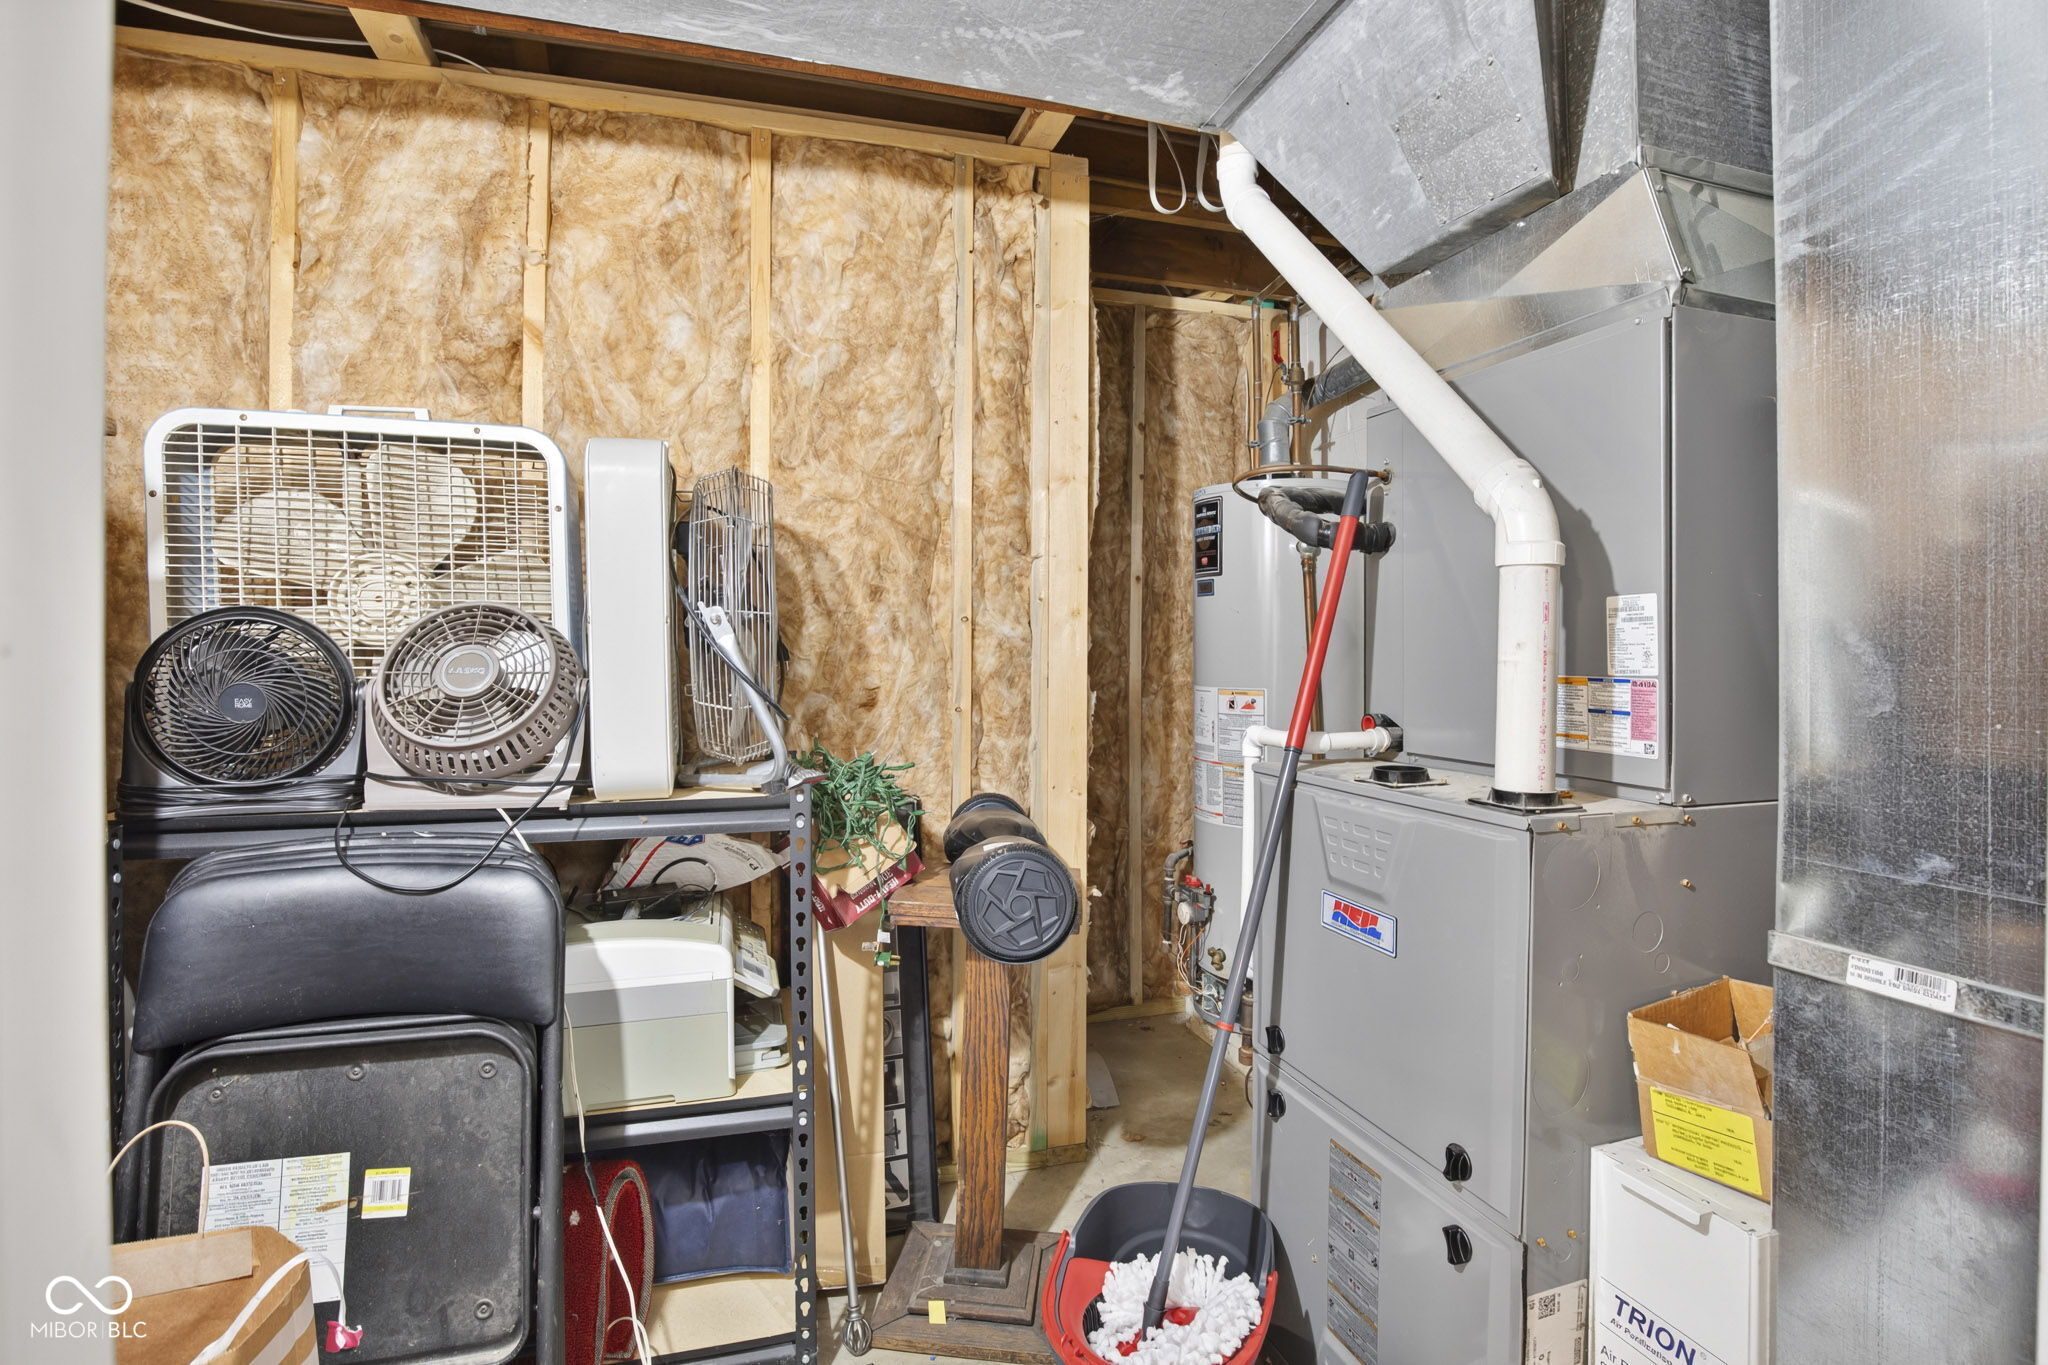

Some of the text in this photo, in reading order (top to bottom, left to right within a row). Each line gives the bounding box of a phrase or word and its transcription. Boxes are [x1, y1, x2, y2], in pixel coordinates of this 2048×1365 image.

[448, 666, 486, 674] LASKO
[1632, 679, 1657, 688] R-410A
[1331, 899, 1382, 941] HEIL
[1610, 1318, 1623, 1329] Air
[1615, 1294, 1697, 1365] TRION
[1600, 1345, 1618, 1363] Air
